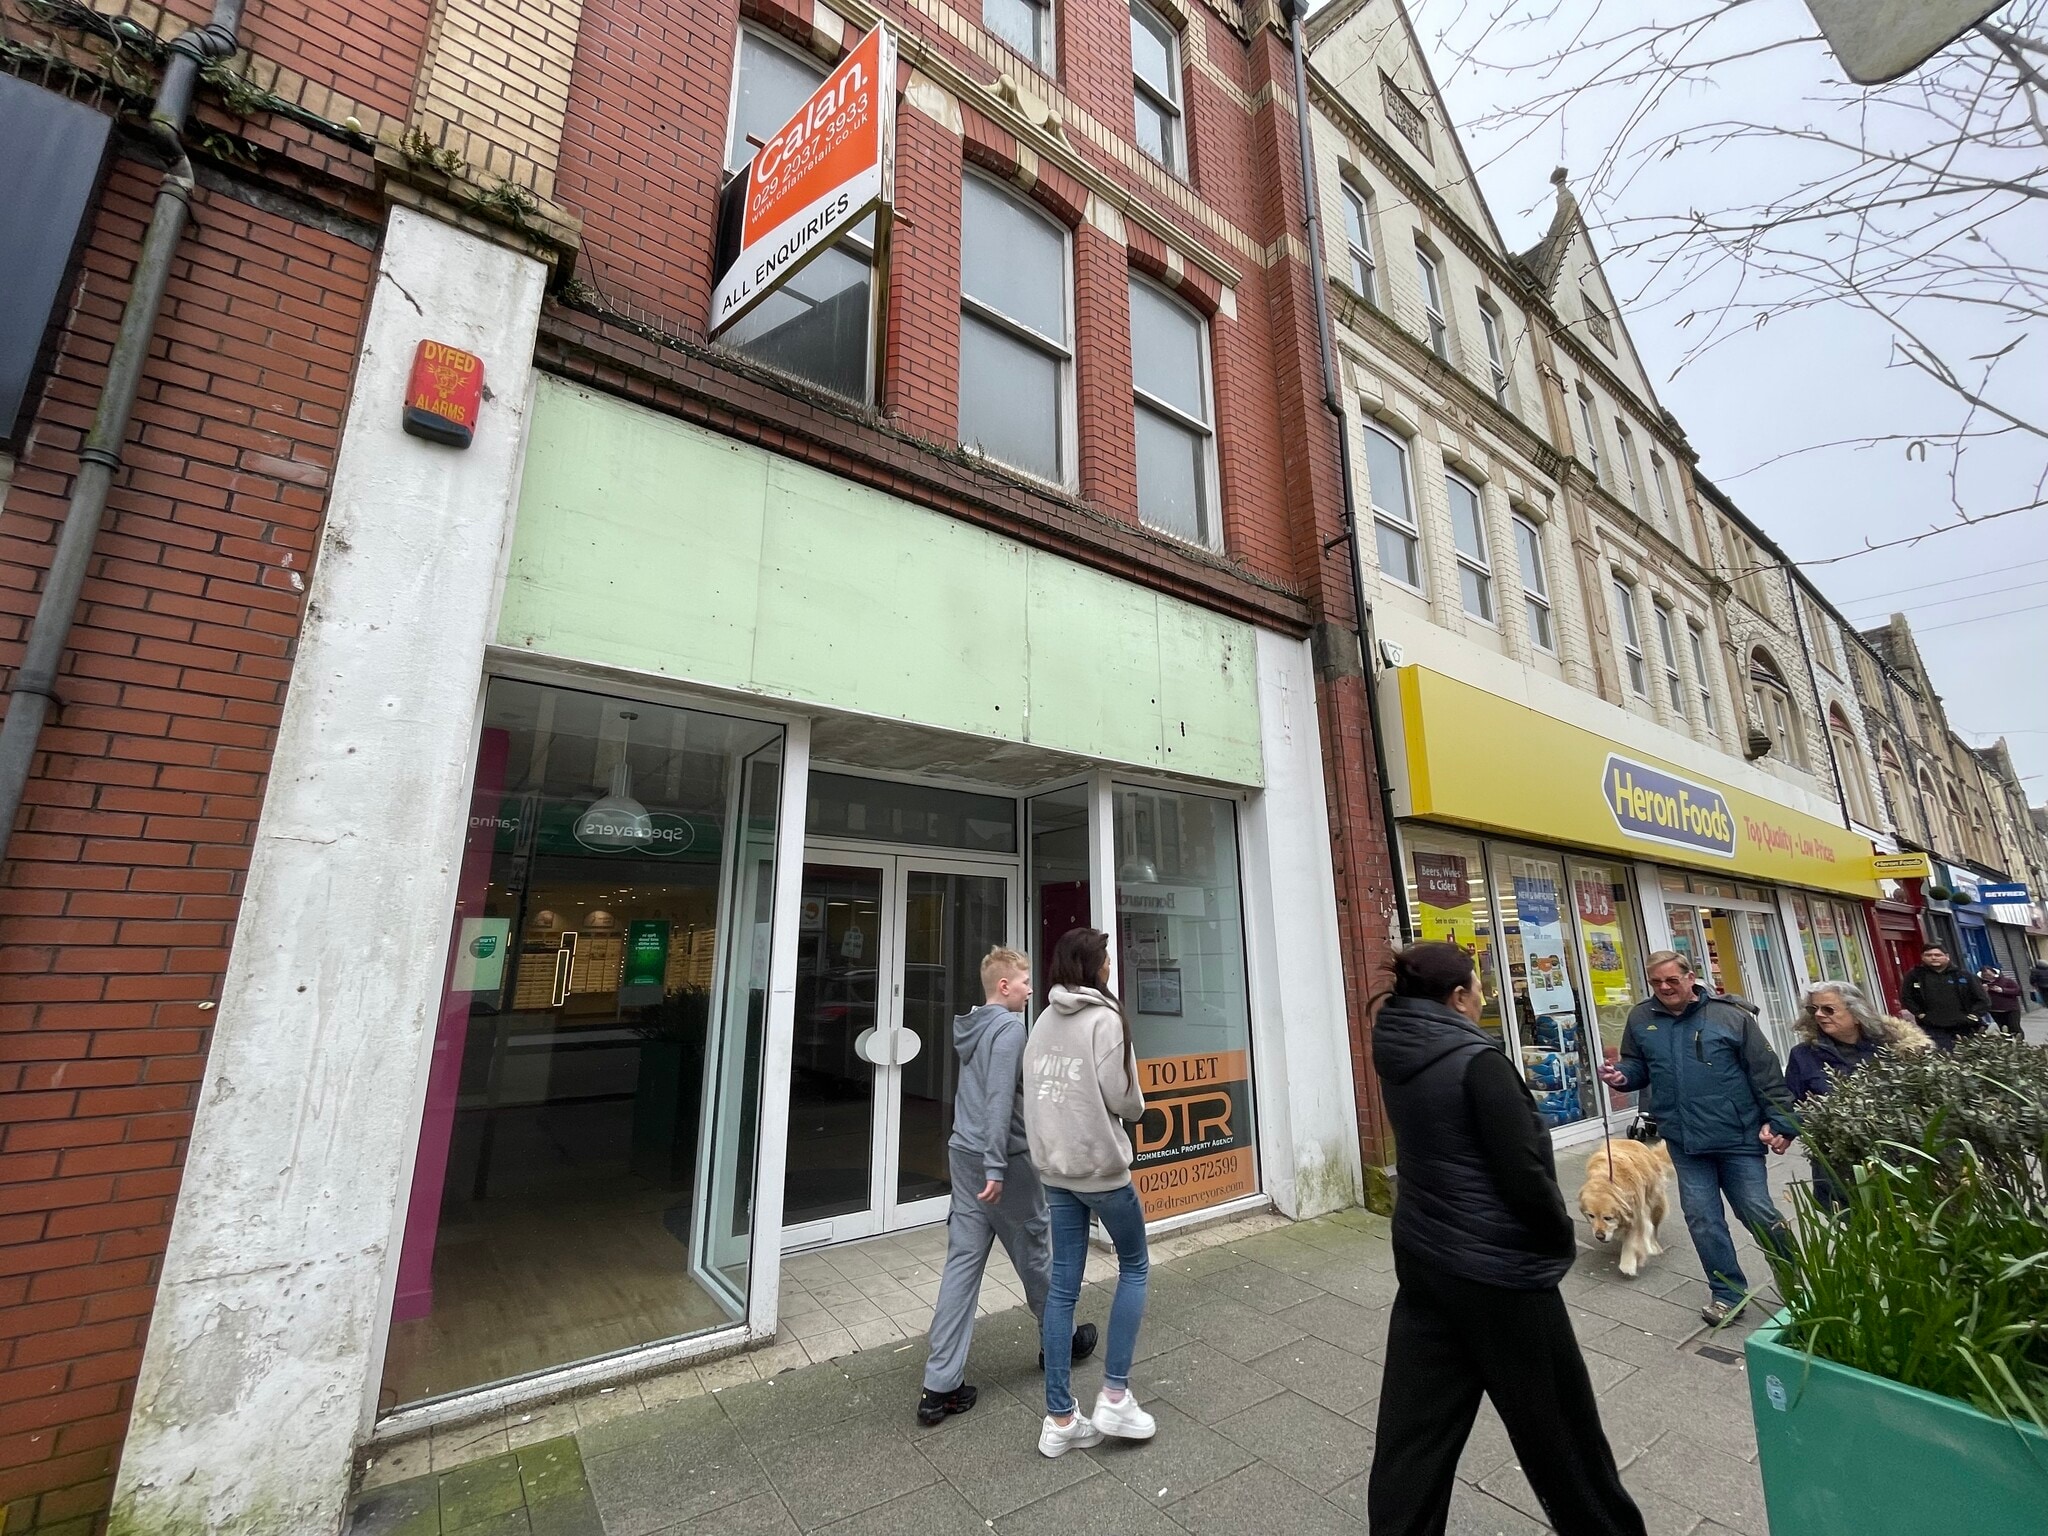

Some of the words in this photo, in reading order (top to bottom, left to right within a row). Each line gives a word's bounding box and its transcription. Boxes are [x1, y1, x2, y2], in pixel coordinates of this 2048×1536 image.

[752, 177, 778, 211] 029
[782, 136, 820, 179] 2037
[826, 92, 869, 143] 3933
[751, 113, 869, 225] www.calanretail.co.uk
[722, 283, 751, 315] ALL
[756, 192, 850, 285] ENQUIRIES
[424, 341, 476, 373] DYFED
[415, 393, 466, 421] ALARMS
[1613, 768, 1679, 829] Heron
[1679, 789, 1731, 842] Foods
[1743, 815, 1762, 851] Top
[1762, 821, 1793, 859] Quality
[1798, 832, 1814, 857] Low
[1813, 838, 1836, 863] Prices
[1421, 865, 1441, 878] Beers,
[1442, 867, 1461, 878] Wines
[1430, 879, 1436, 890] &
[1436, 879, 1457, 891] Ciders
[1583, 892, 1592, 914] 3
[1985, 890, 2026, 898] BETFRED
[1148, 1062, 1177, 1086] TO
[1182, 1057, 1219, 1082] LET
[1135, 1091, 1233, 1153] DTR
[1136, 1148, 1180, 1162] COMMERCIAL
[1181, 1140, 1211, 1154] PROPERTY
[1211, 1136, 1234, 1148] AGENCY
[1140, 1166, 1188, 1194] 02920
[1192, 1155, 1238, 1183] 372599
[1143, 1180, 1244, 1214] fo@dtrsurveyors.com
